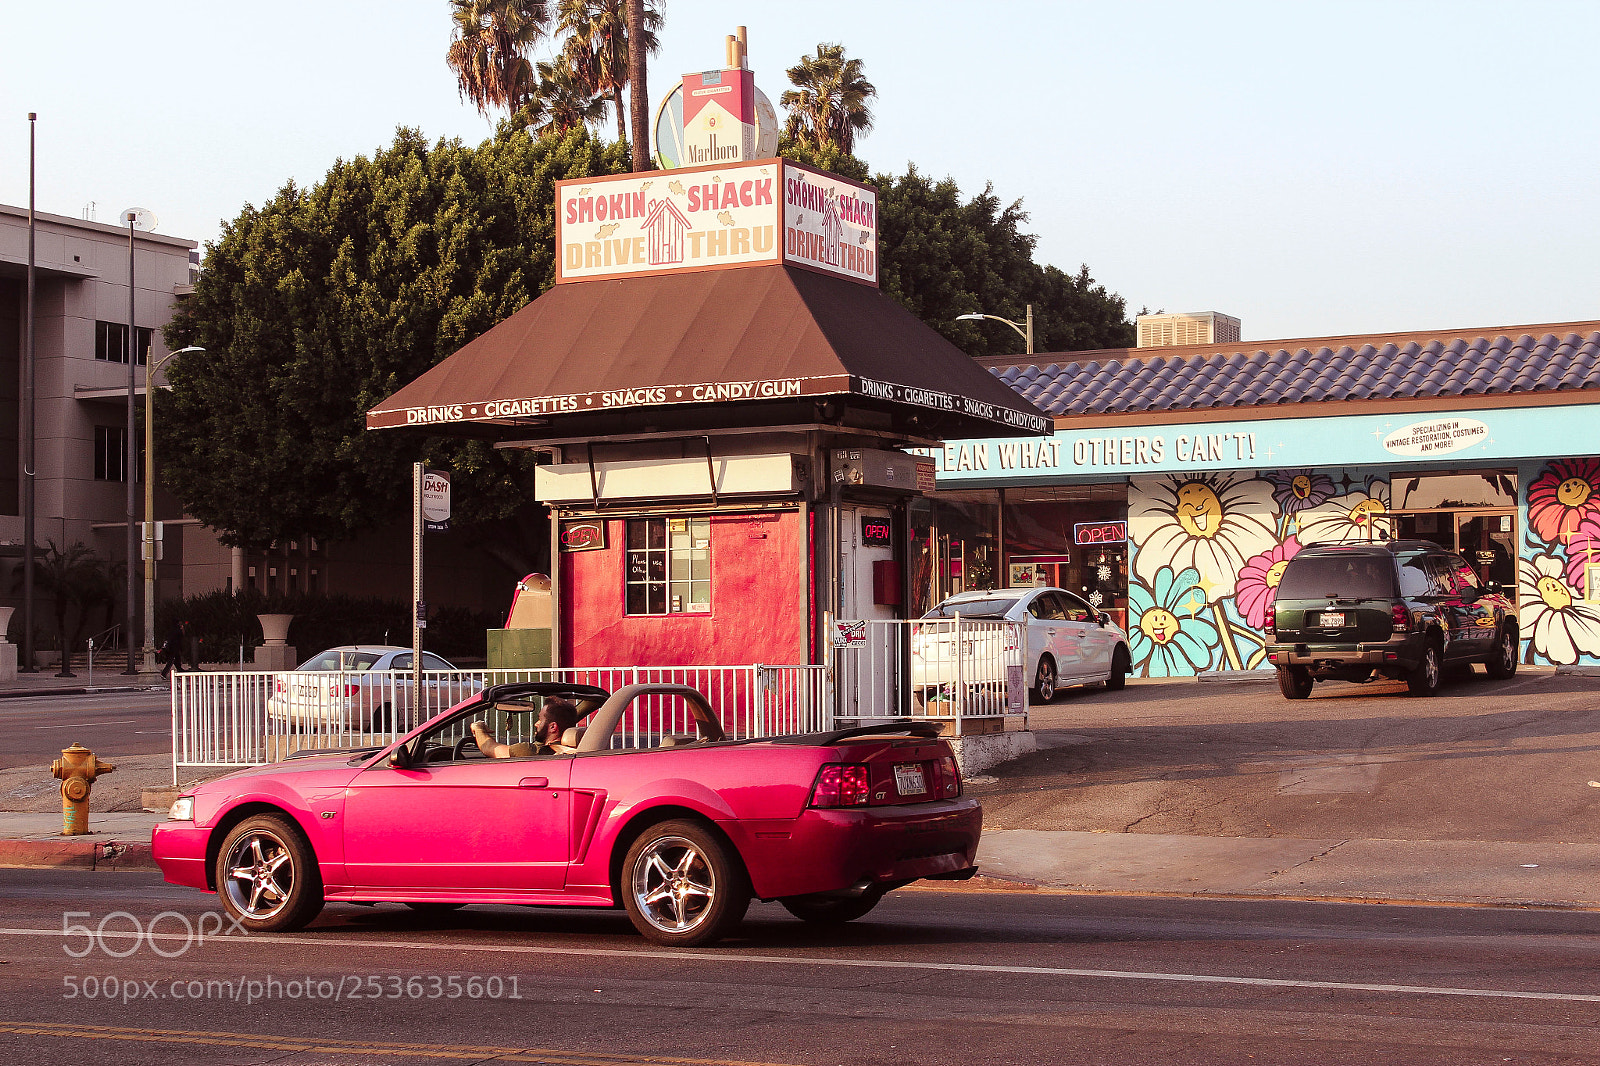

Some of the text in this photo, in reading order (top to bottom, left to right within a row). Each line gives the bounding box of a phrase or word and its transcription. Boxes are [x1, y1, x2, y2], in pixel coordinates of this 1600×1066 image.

[688, 134, 738, 164] Marlboro
[566, 178, 773, 224] SMOKIN SHACK
[787, 177, 874, 228] SMOKIN SHACK
[566, 225, 774, 270] DRIVE THRU
[788, 227, 874, 276] DRIVE THRU
[406, 380, 802, 424] DRINKS CIGARETTES SNACKS CANDY/GUM
[862, 380, 1047, 432] DRINKS CIGARETTES SNACKS CANDY/GUM
[1412, 422, 1459, 436] SPECIALIZING IN
[913, 432, 1257, 472] EAN WHAT OTHERS CAN'T!
[1386, 438, 1410, 448] VINTAGE
[1420, 440, 1454, 452] AND MORE!
[424, 480, 448, 492] DASH
[560, 528, 600, 544] OPEN
[864, 524, 890, 540] OPEN
[1078, 524, 1125, 544] OPEN
[875, 792, 886, 800] GT
[320, 810, 336, 819] GT
